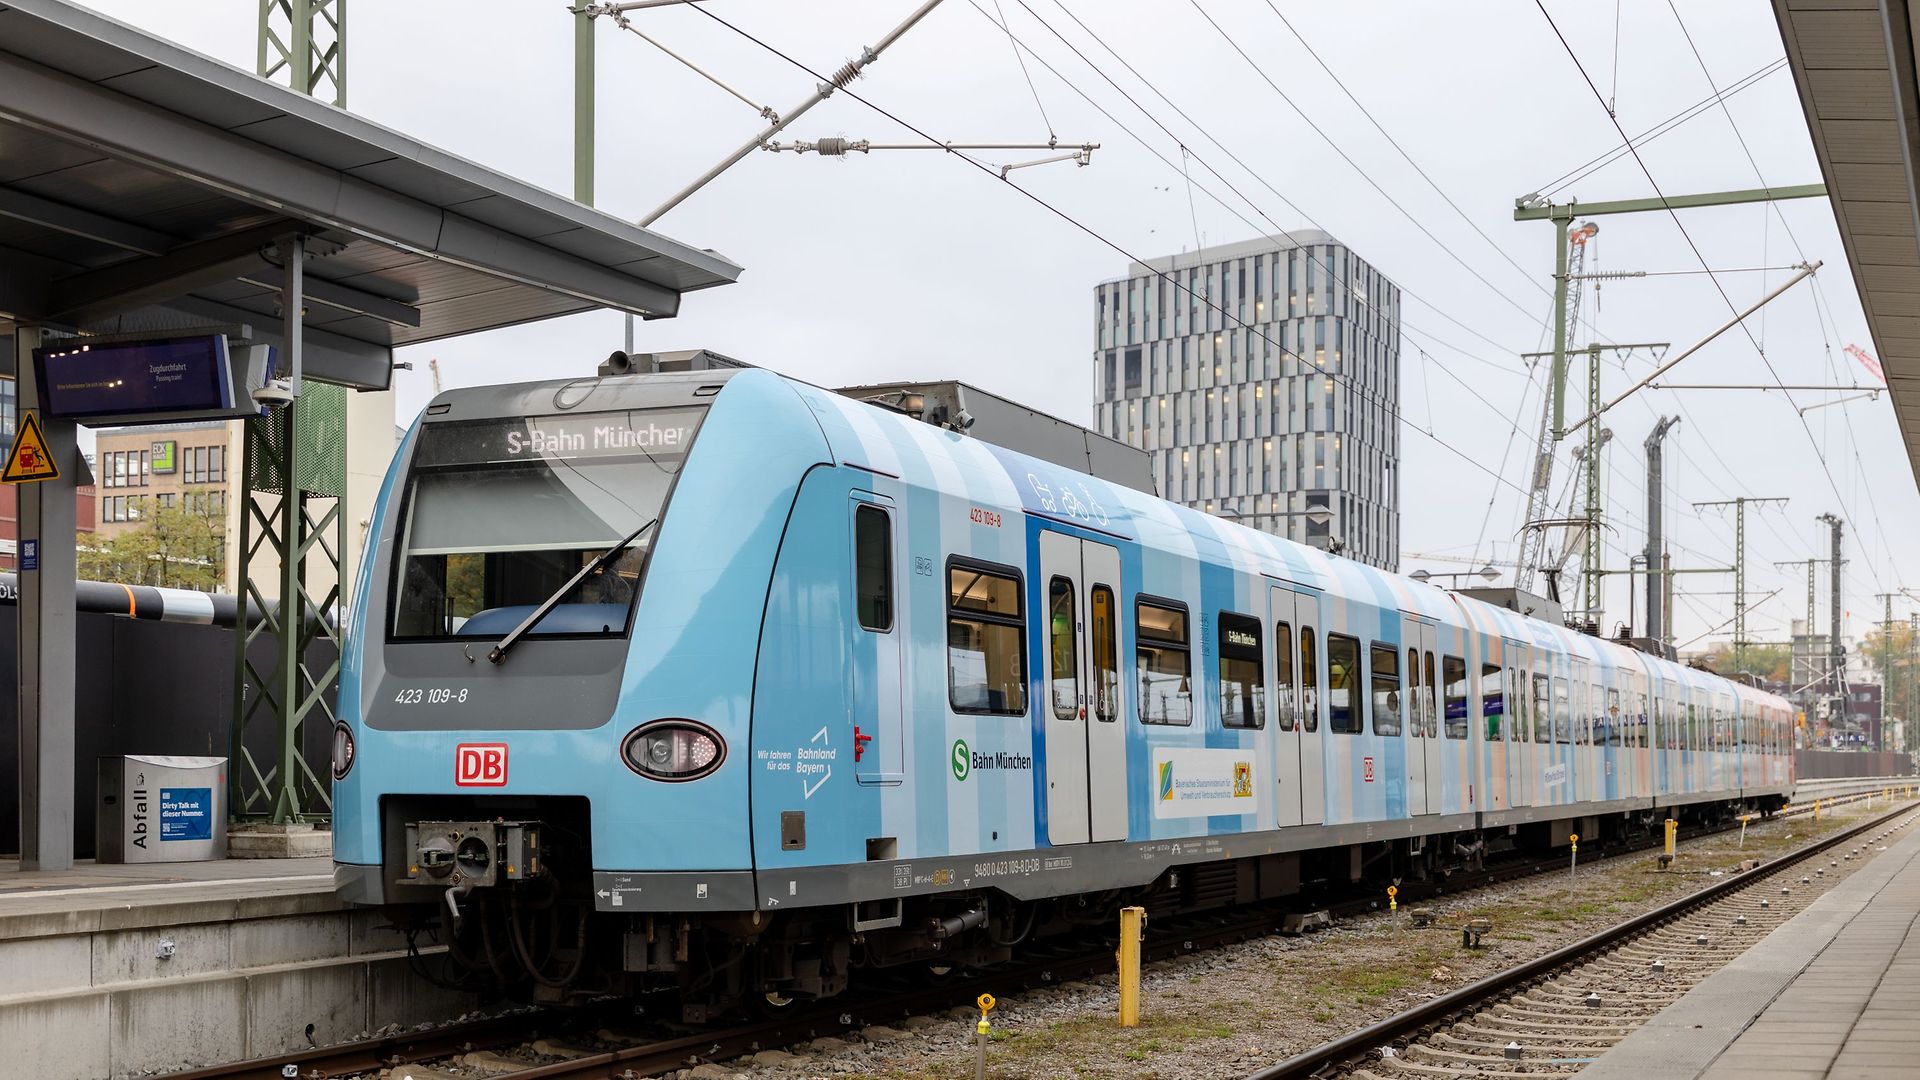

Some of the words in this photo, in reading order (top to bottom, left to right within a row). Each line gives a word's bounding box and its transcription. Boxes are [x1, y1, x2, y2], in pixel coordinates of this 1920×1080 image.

[149, 363, 187, 375] Zugdurchfahrt
[507, 429, 585, 454] S-Bahn
[970, 508, 982, 523] 423
[984, 511, 1001, 528] 109-8
[395, 689, 424, 704] 423
[427, 688, 469, 704] 109-8
[757, 750, 769, 759] Wir
[769, 750, 792, 760] fahren
[797, 747, 837, 760] Bahnland
[954, 742, 968, 778] S
[972, 751, 994, 770] Bahn
[995, 751, 1032, 770] München
[459, 747, 505, 782] DB
[766, 761, 777, 770] für
[777, 761, 791, 770] das
[796, 761, 825, 775] Bayern
[1365, 758, 1373, 780] DB
[162, 802, 178, 811] Dirty
[178, 801, 189, 809] Talk
[190, 801, 199, 809] mit
[133, 790, 147, 850] Abfall
